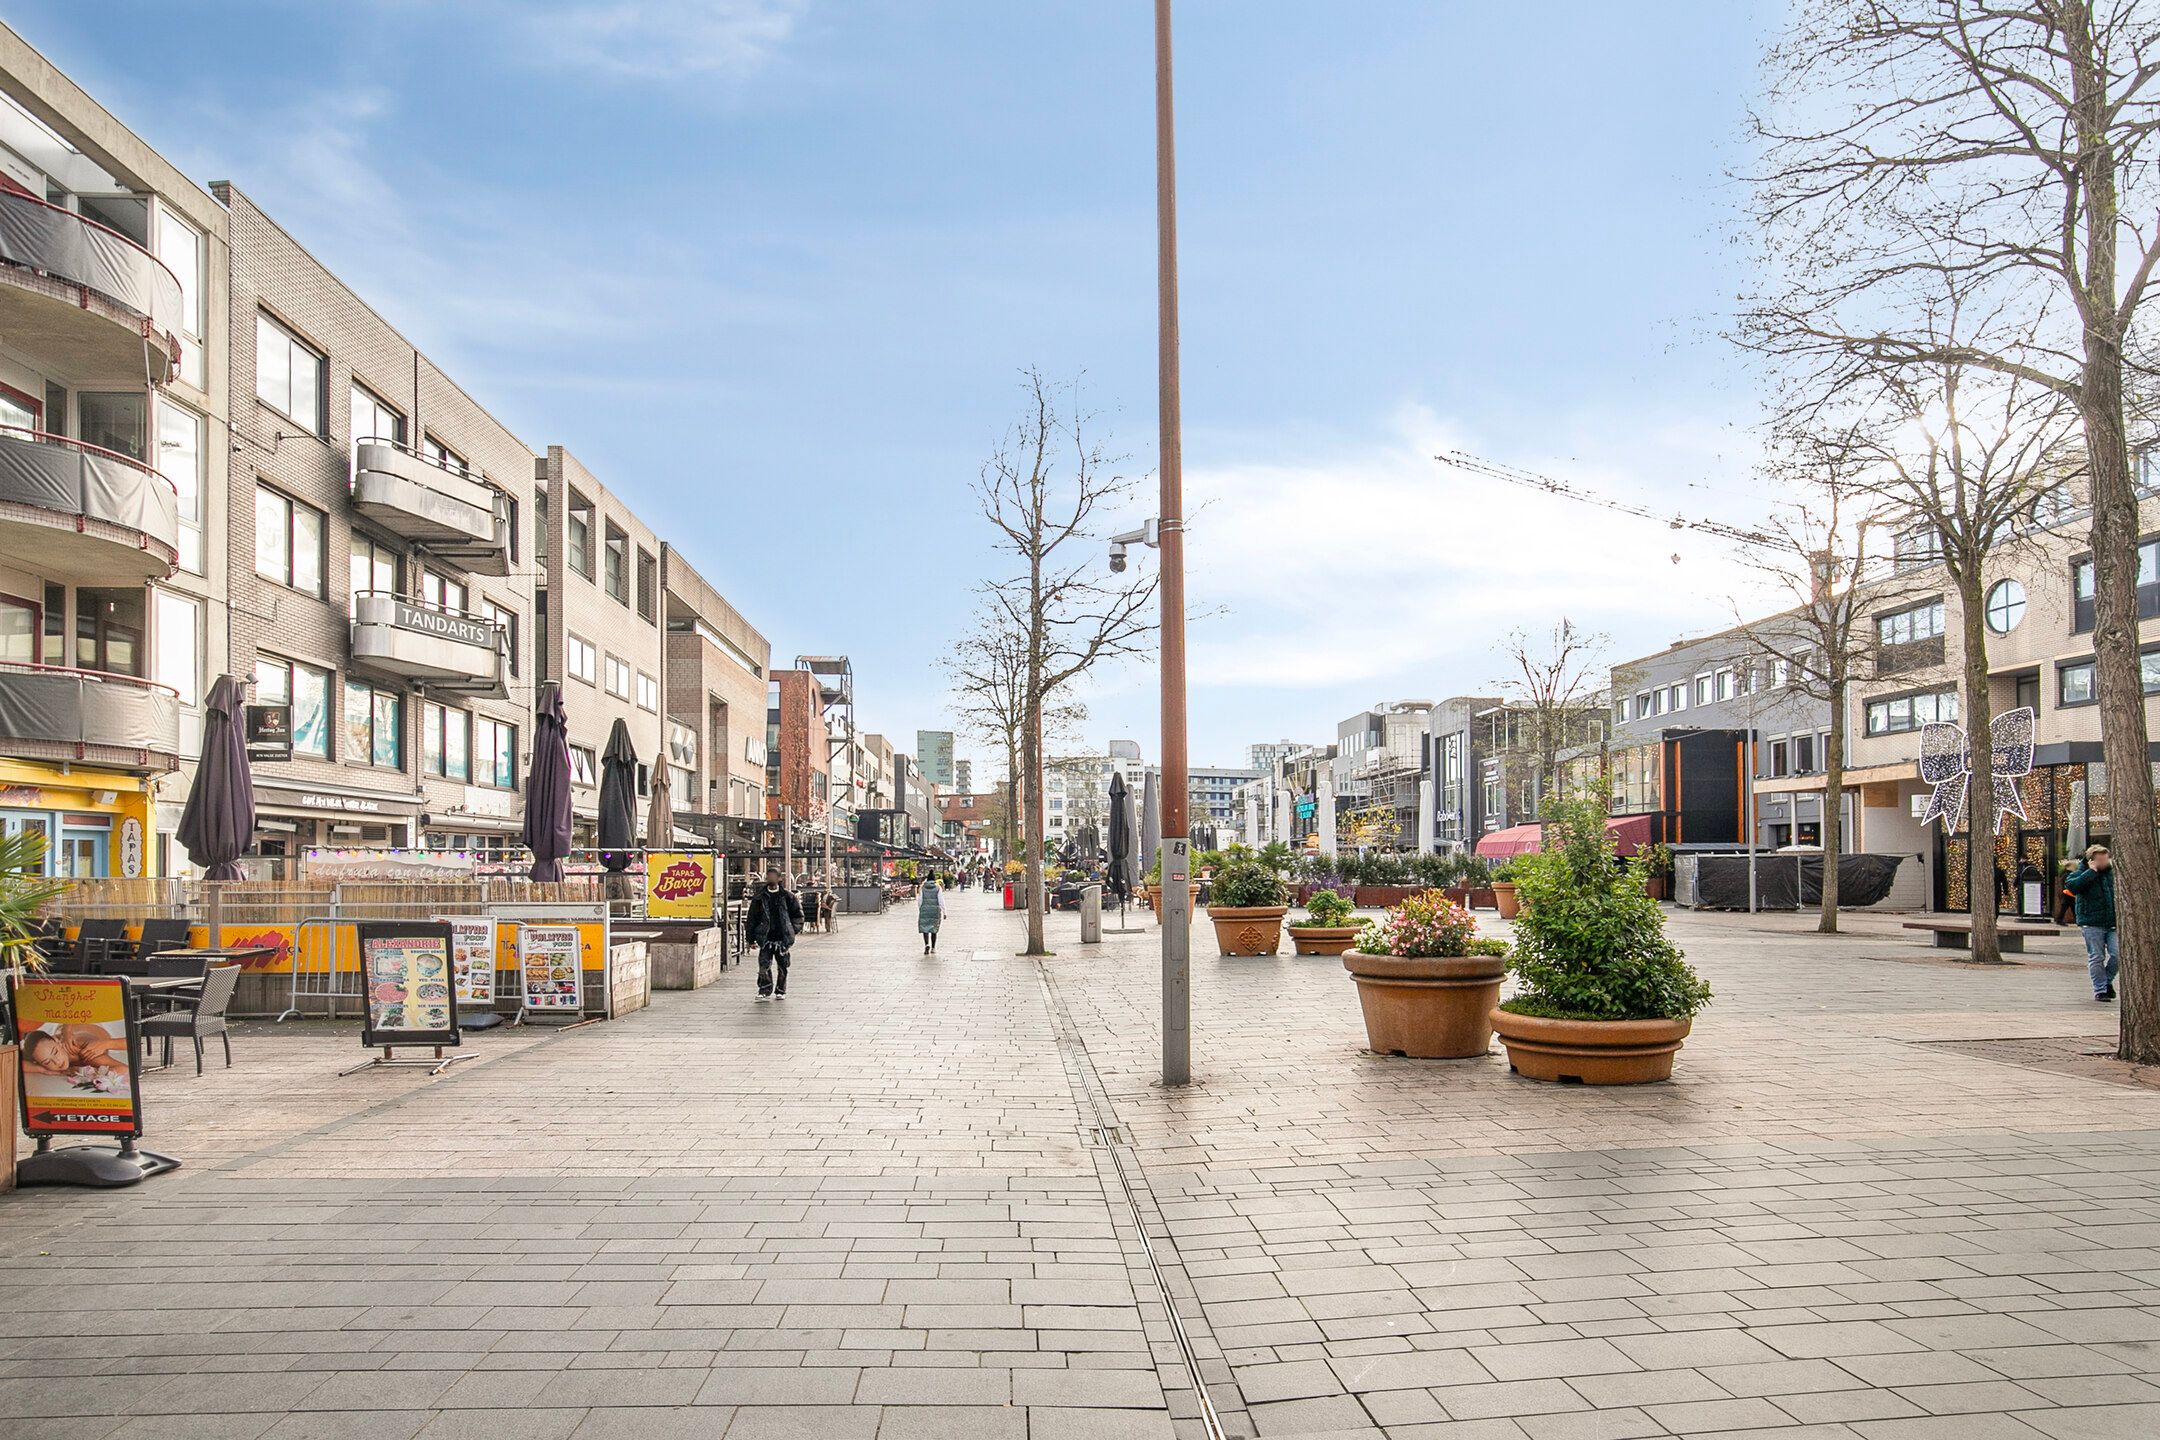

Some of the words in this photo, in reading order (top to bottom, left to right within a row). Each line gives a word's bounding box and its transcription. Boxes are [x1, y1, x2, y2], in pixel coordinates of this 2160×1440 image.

[402, 608, 485, 643] TANDARTS
[126, 822, 137, 875] TAPAS
[671, 869, 695, 877] TAPAS
[658, 876, 704, 892] Barça
[44, 1009, 92, 1023] massage
[67, 1114, 120, 1123] ETAGE
